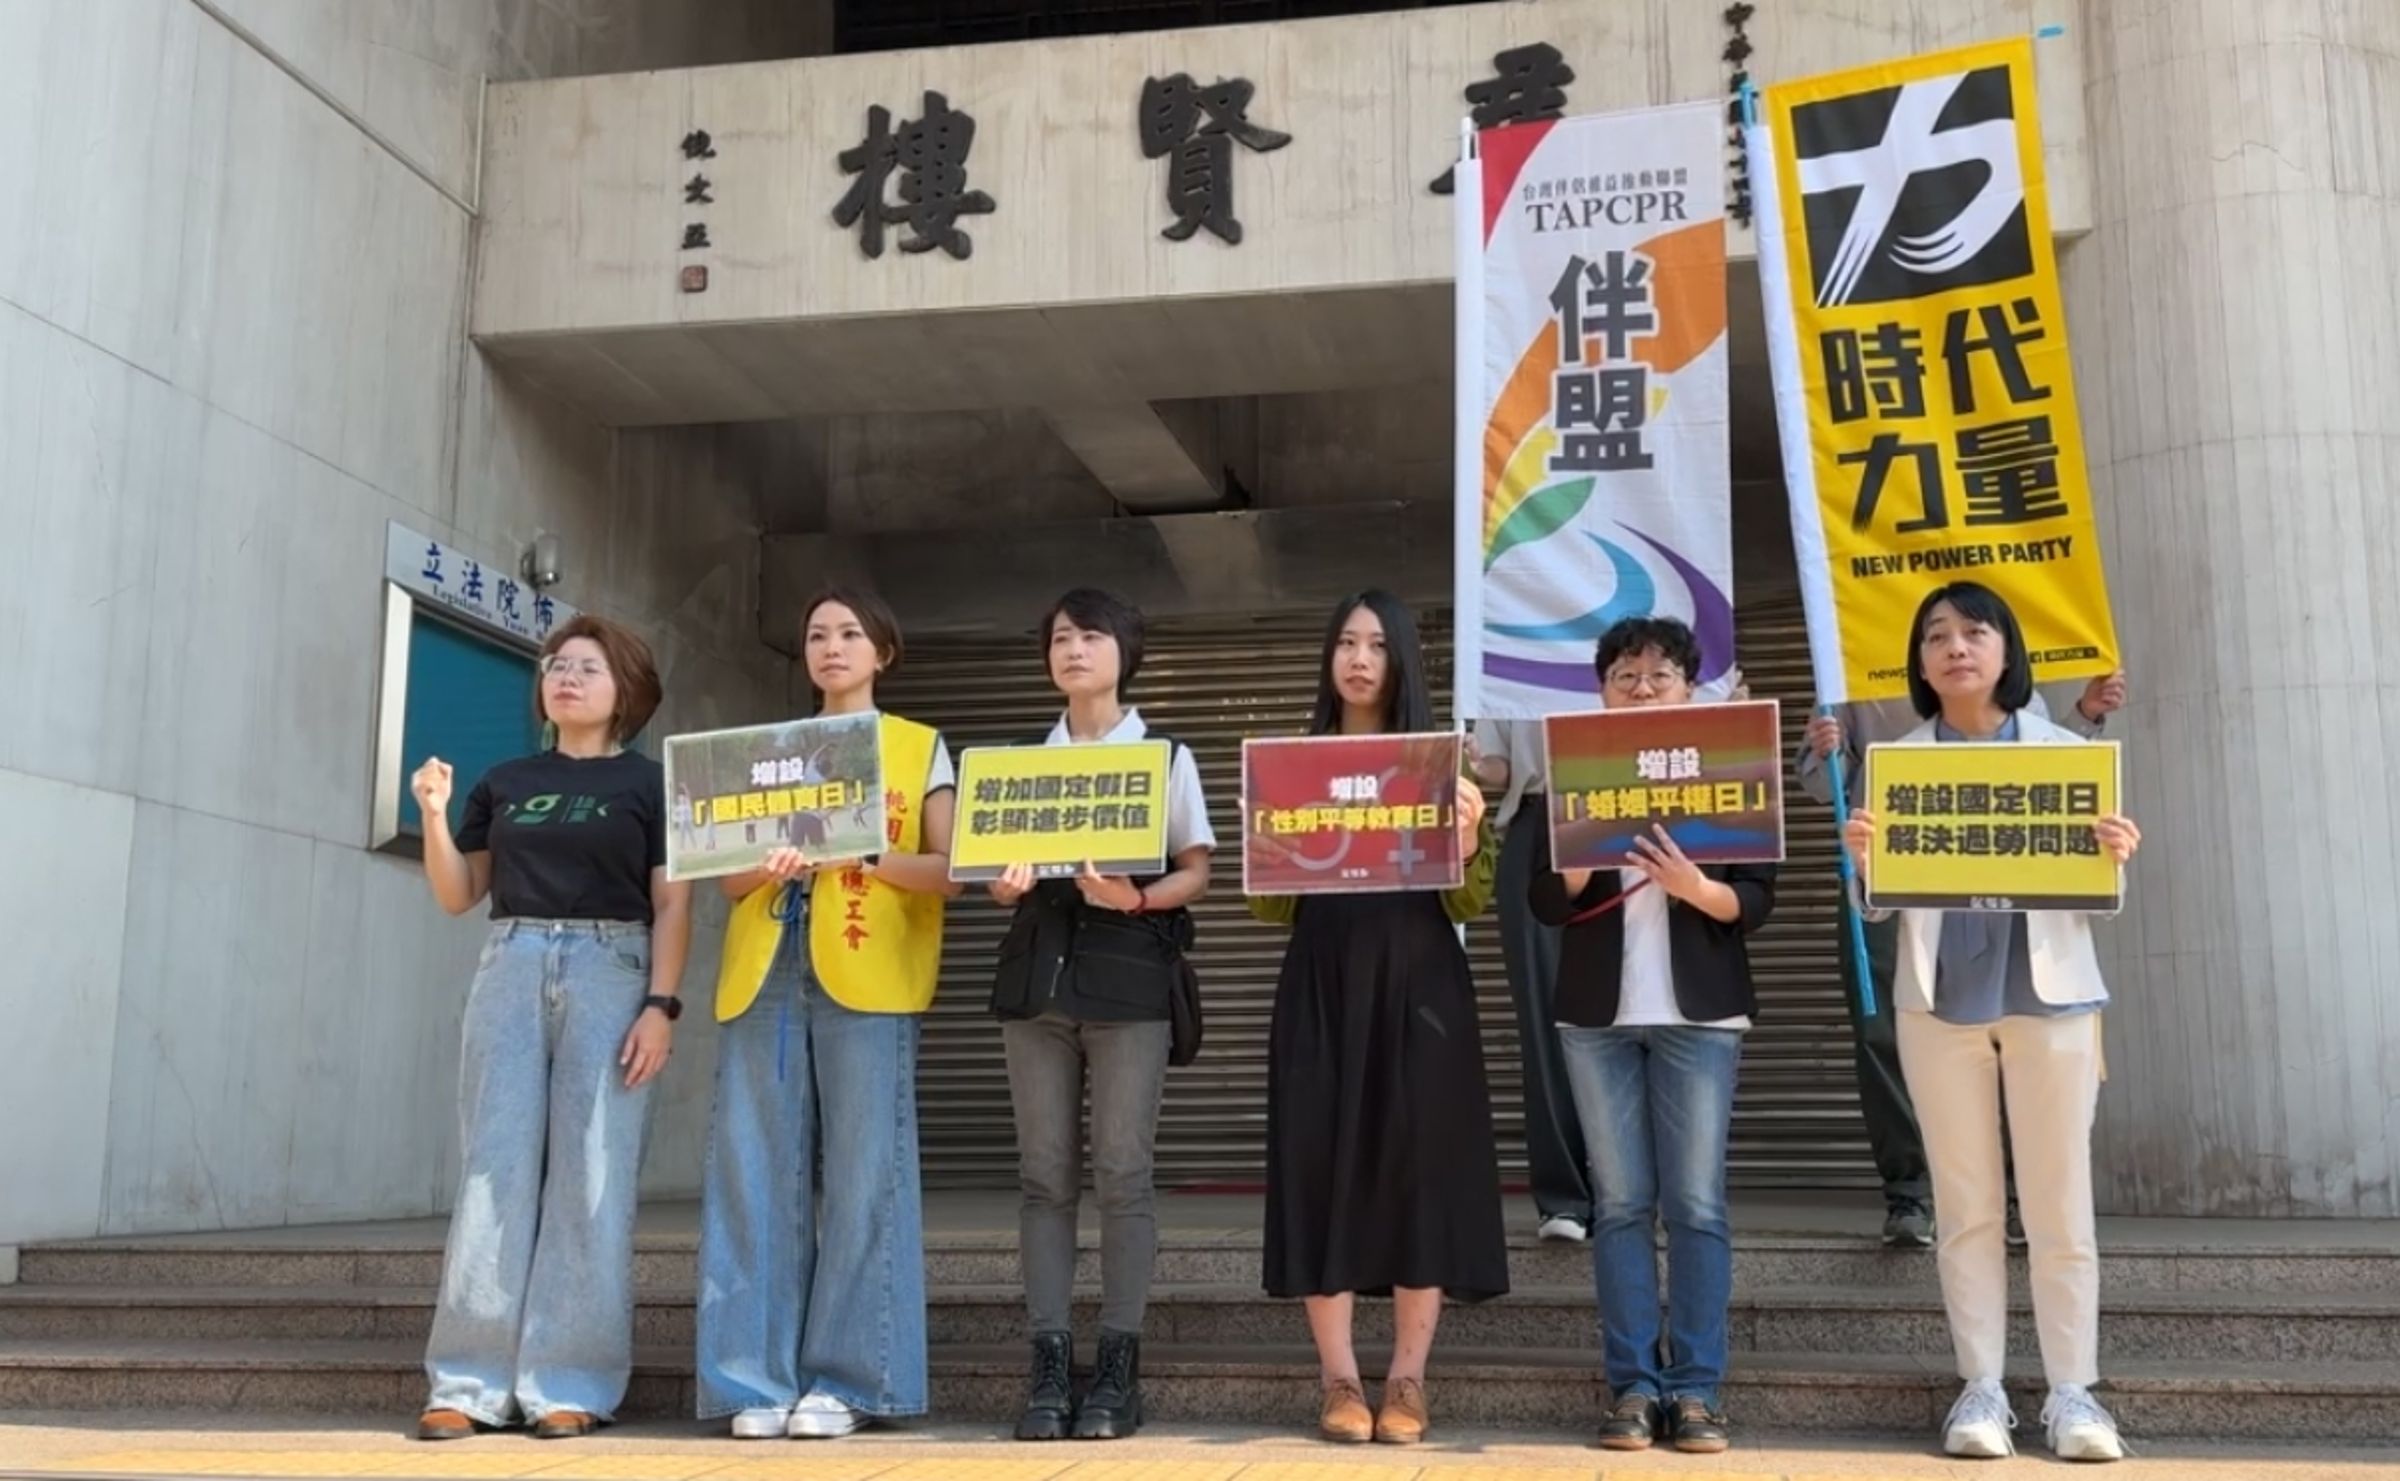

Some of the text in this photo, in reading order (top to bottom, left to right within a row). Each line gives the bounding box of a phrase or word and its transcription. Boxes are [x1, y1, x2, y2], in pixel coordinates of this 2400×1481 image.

[1525, 190, 1688, 233] TAPCPR
[1549, 250, 1654, 471] 伴盟
[1820, 297, 2053, 425] 時代
[1837, 414, 2069, 534] 力量
[1851, 536, 2073, 578] NEW POWER PARTY
[1636, 747, 1701, 780] 增設
[974, 771, 1152, 804] 增加國定假日
[1329, 775, 1379, 800] 增設
[1565, 782, 1767, 821] 「婚姻平權日」
[1885, 783, 2099, 816] 增設國定假日
[1254, 804, 1454, 834] 「性別平等教育日」
[1885, 824, 2101, 857] 解決過勞問題
